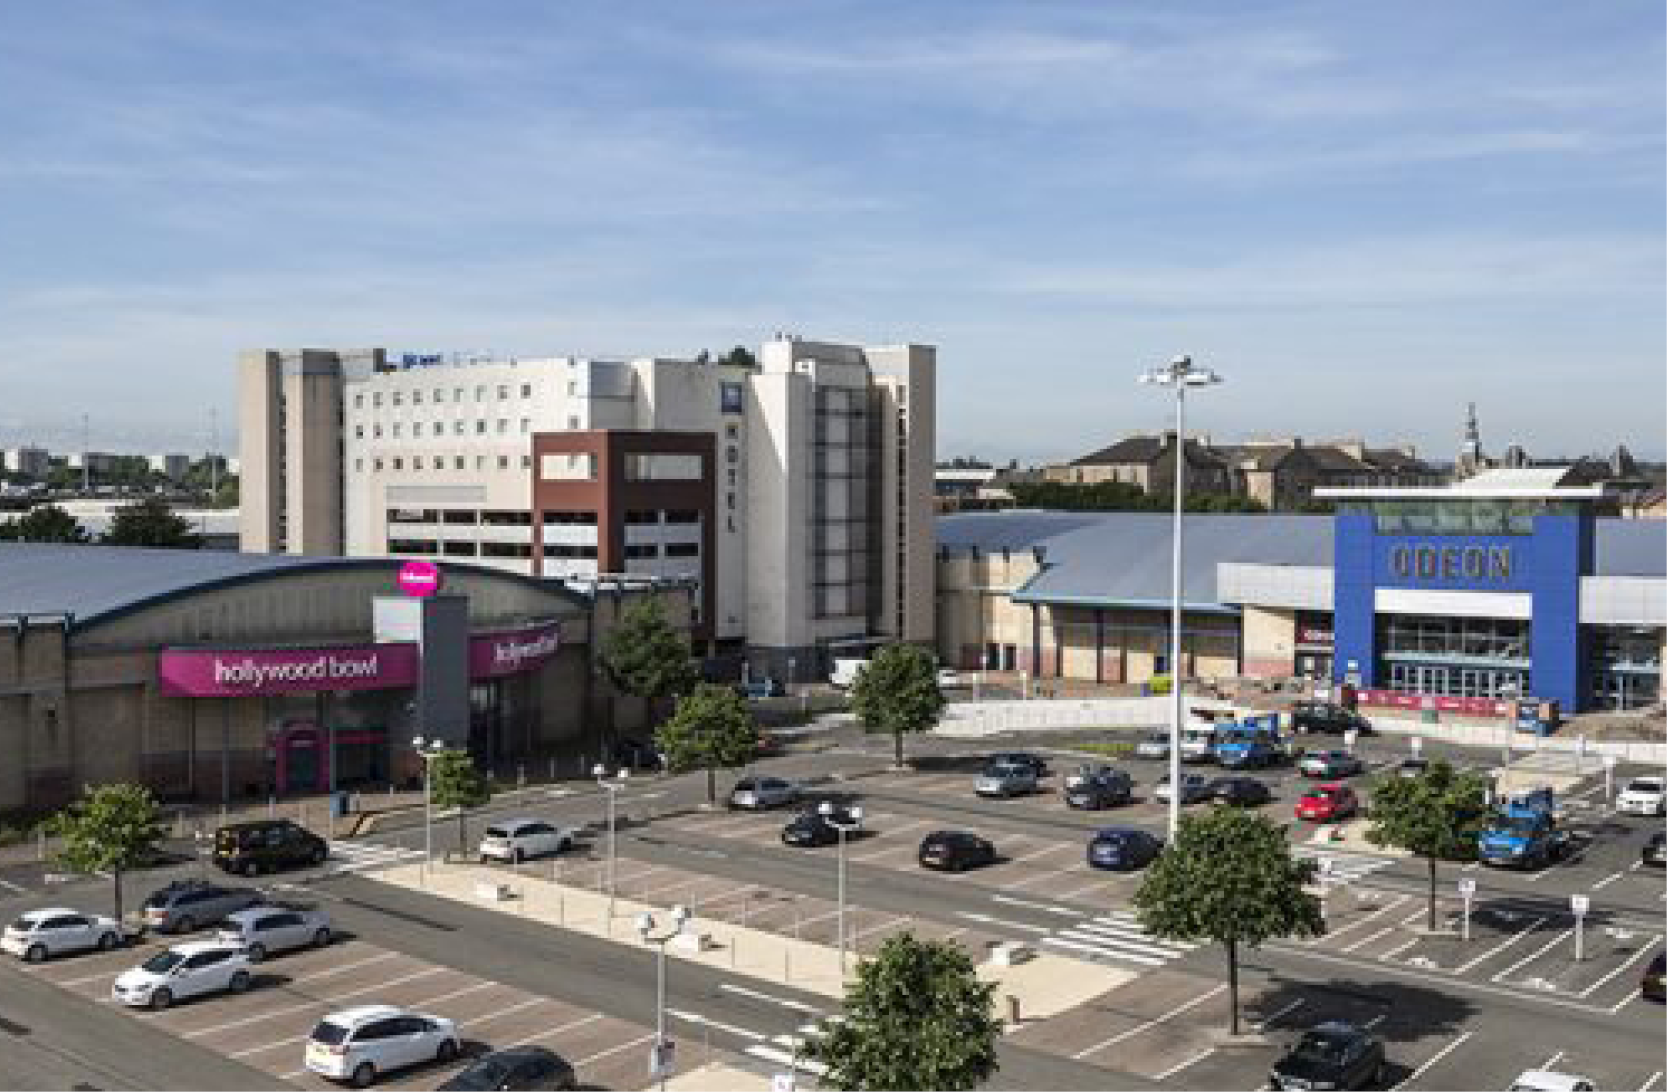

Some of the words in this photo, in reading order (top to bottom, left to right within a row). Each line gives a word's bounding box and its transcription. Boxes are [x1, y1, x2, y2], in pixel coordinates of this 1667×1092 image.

[1388, 542, 1512, 583] ODEON
[214, 656, 327, 688] hollywood
[329, 652, 378, 679] bowl
